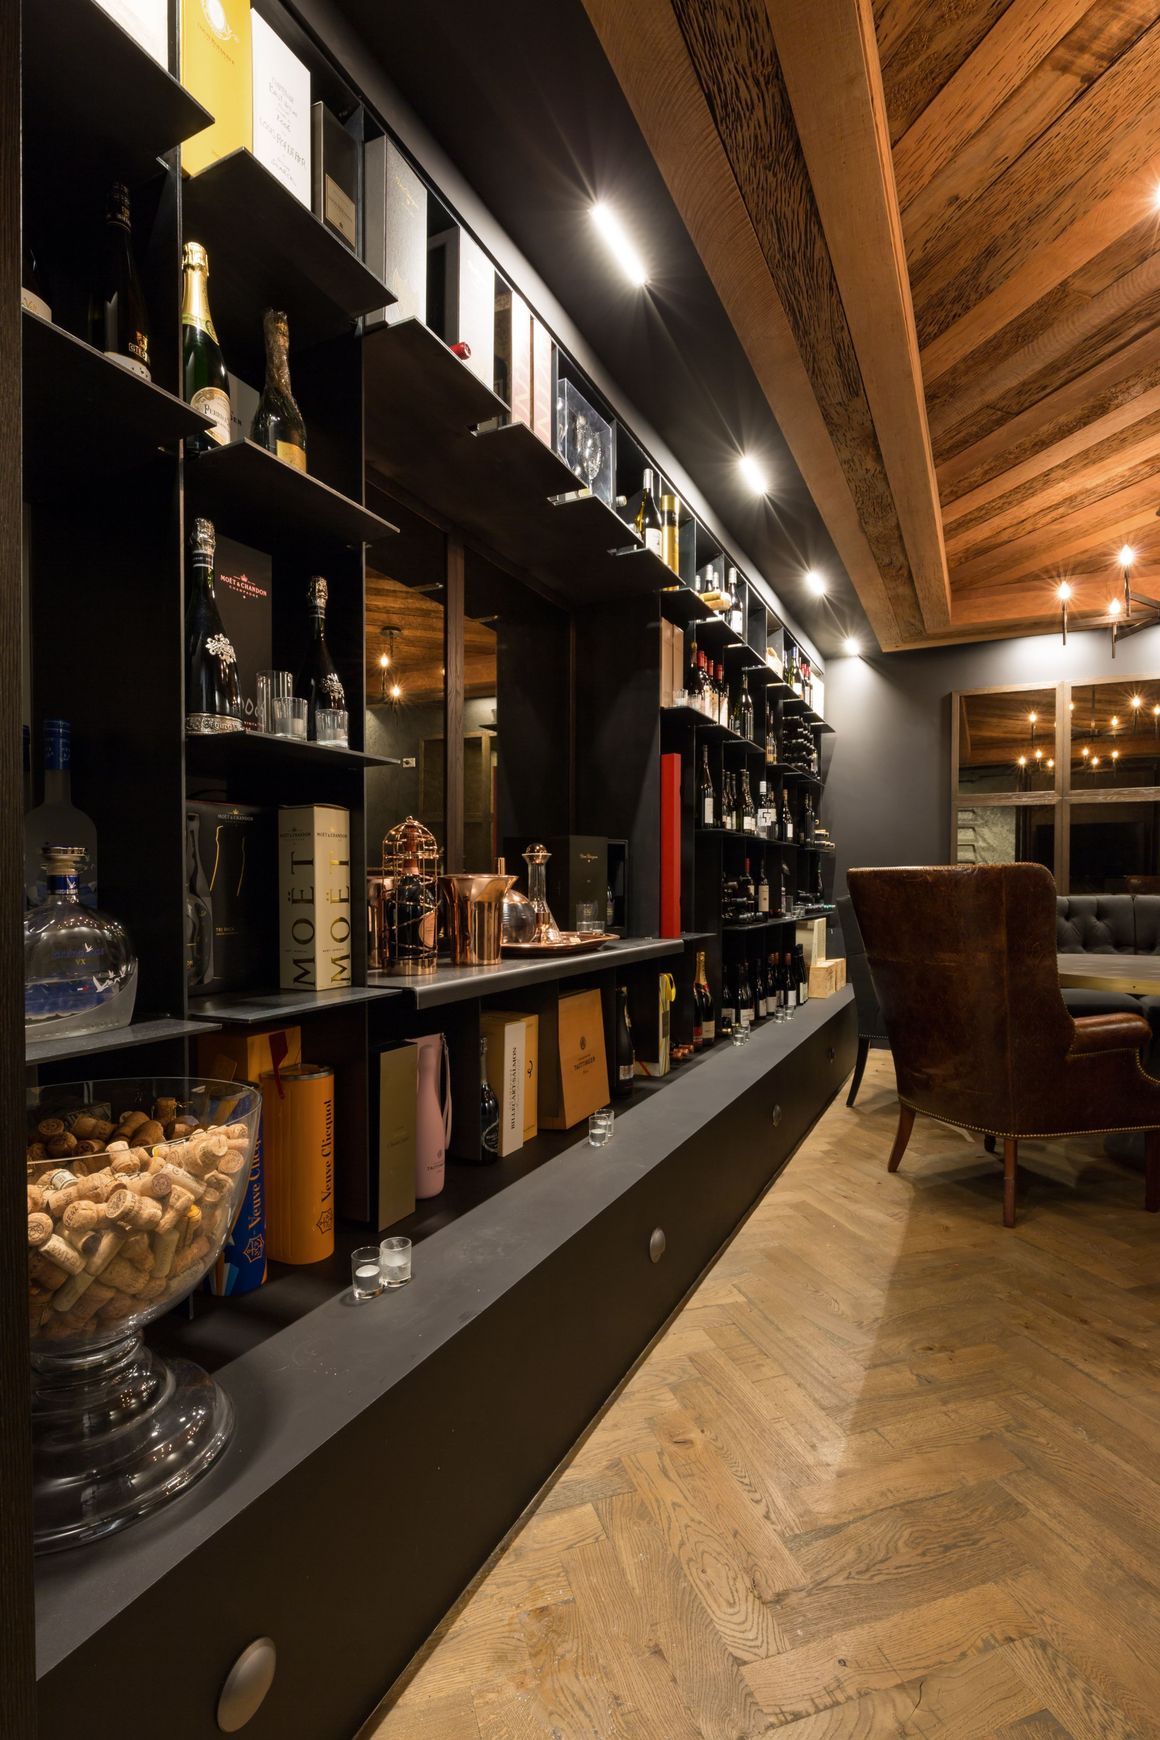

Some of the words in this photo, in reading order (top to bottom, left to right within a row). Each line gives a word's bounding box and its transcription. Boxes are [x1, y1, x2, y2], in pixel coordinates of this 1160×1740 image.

[240, 583, 268, 597] CHANDON
[287, 851, 315, 987] MOËT
[326, 852, 351, 984] MOËT
[320, 1099, 334, 1158] Clicquot
[248, 1183, 262, 1231] Veuve
[321, 1158, 333, 1203] Veuve
